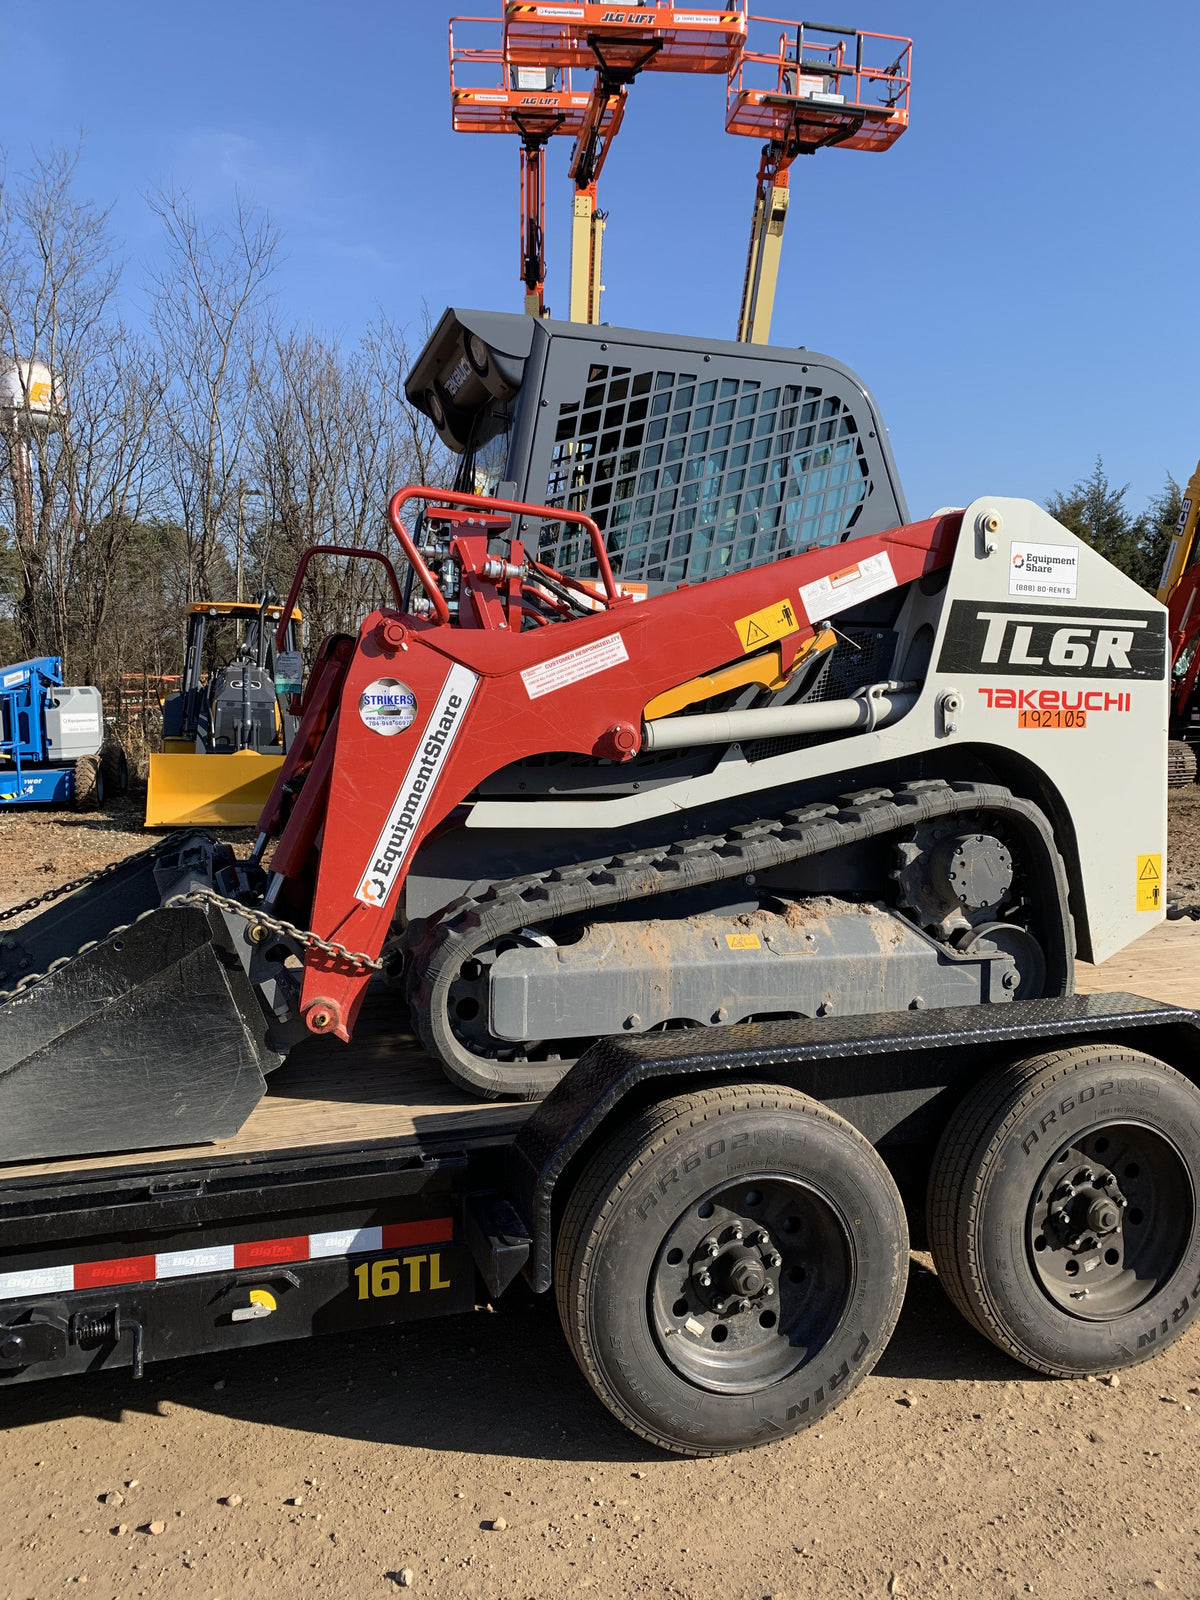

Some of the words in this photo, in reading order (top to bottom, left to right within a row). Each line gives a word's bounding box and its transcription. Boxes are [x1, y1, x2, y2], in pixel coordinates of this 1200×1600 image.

[601, 12, 624, 23] JLG
[626, 13, 656, 25] LIFT
[520, 97, 537, 106] JLG
[538, 98, 559, 106] LIFT
[1176, 499, 1192, 536] JCB
[1026, 553, 1076, 566] Equipment
[1025, 563, 1053, 573] Share
[1016, 583, 1036, 592] (888)
[976, 611, 1148, 670] TL6R
[544, 653, 575, 670] CUSTOMER
[575, 634, 621, 657] RESPONSIBILITY
[363, 694, 414, 705] STRIKERS
[1020, 711, 1086, 728] 192105
[373, 694, 463, 876] EquipmentShare
[172, 1254, 217, 1267] BigTex
[91, 1265, 138, 1278] BigTex
[354, 1253, 451, 1300] 16TL
